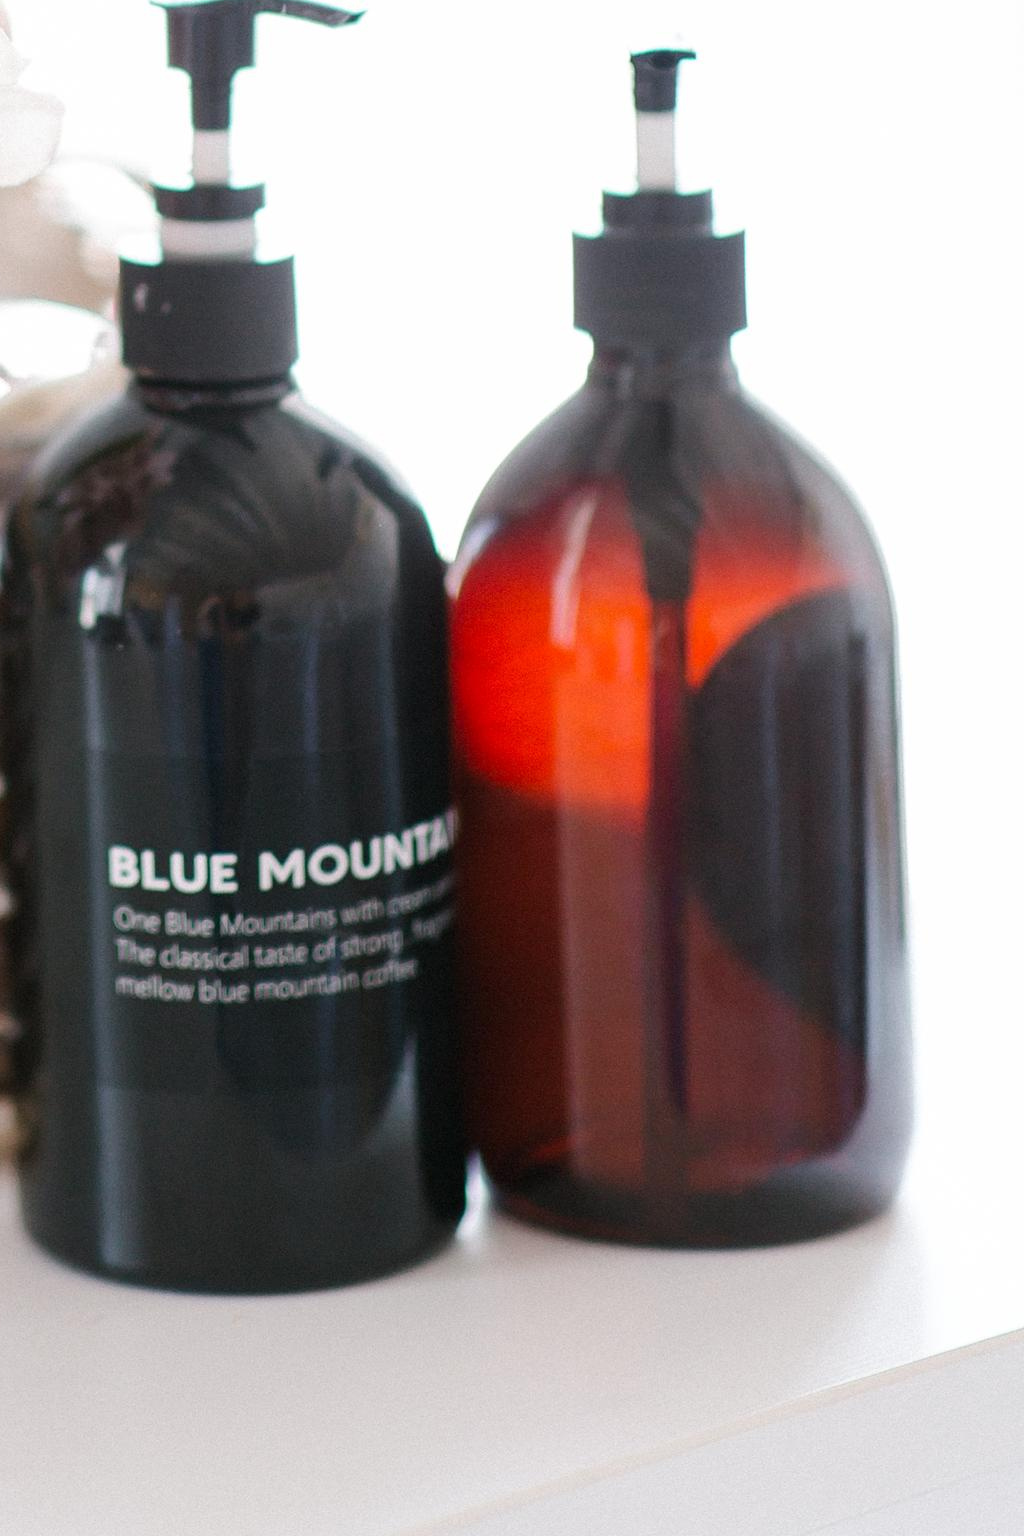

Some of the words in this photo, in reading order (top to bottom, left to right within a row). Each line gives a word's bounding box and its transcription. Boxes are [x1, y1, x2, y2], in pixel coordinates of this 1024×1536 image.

[108, 845, 239, 894] BLUE
[113, 905, 161, 934] One
[164, 909, 215, 938] Blue
[219, 907, 337, 937] Mountains
[340, 898, 385, 925] with
[115, 937, 157, 966] The
[159, 944, 249, 970] classical
[253, 942, 309, 968] taste
[312, 935, 337, 963] of
[115, 976, 195, 1001] mellow
[198, 978, 251, 1004] blue
[254, 970, 360, 1002] mountain
